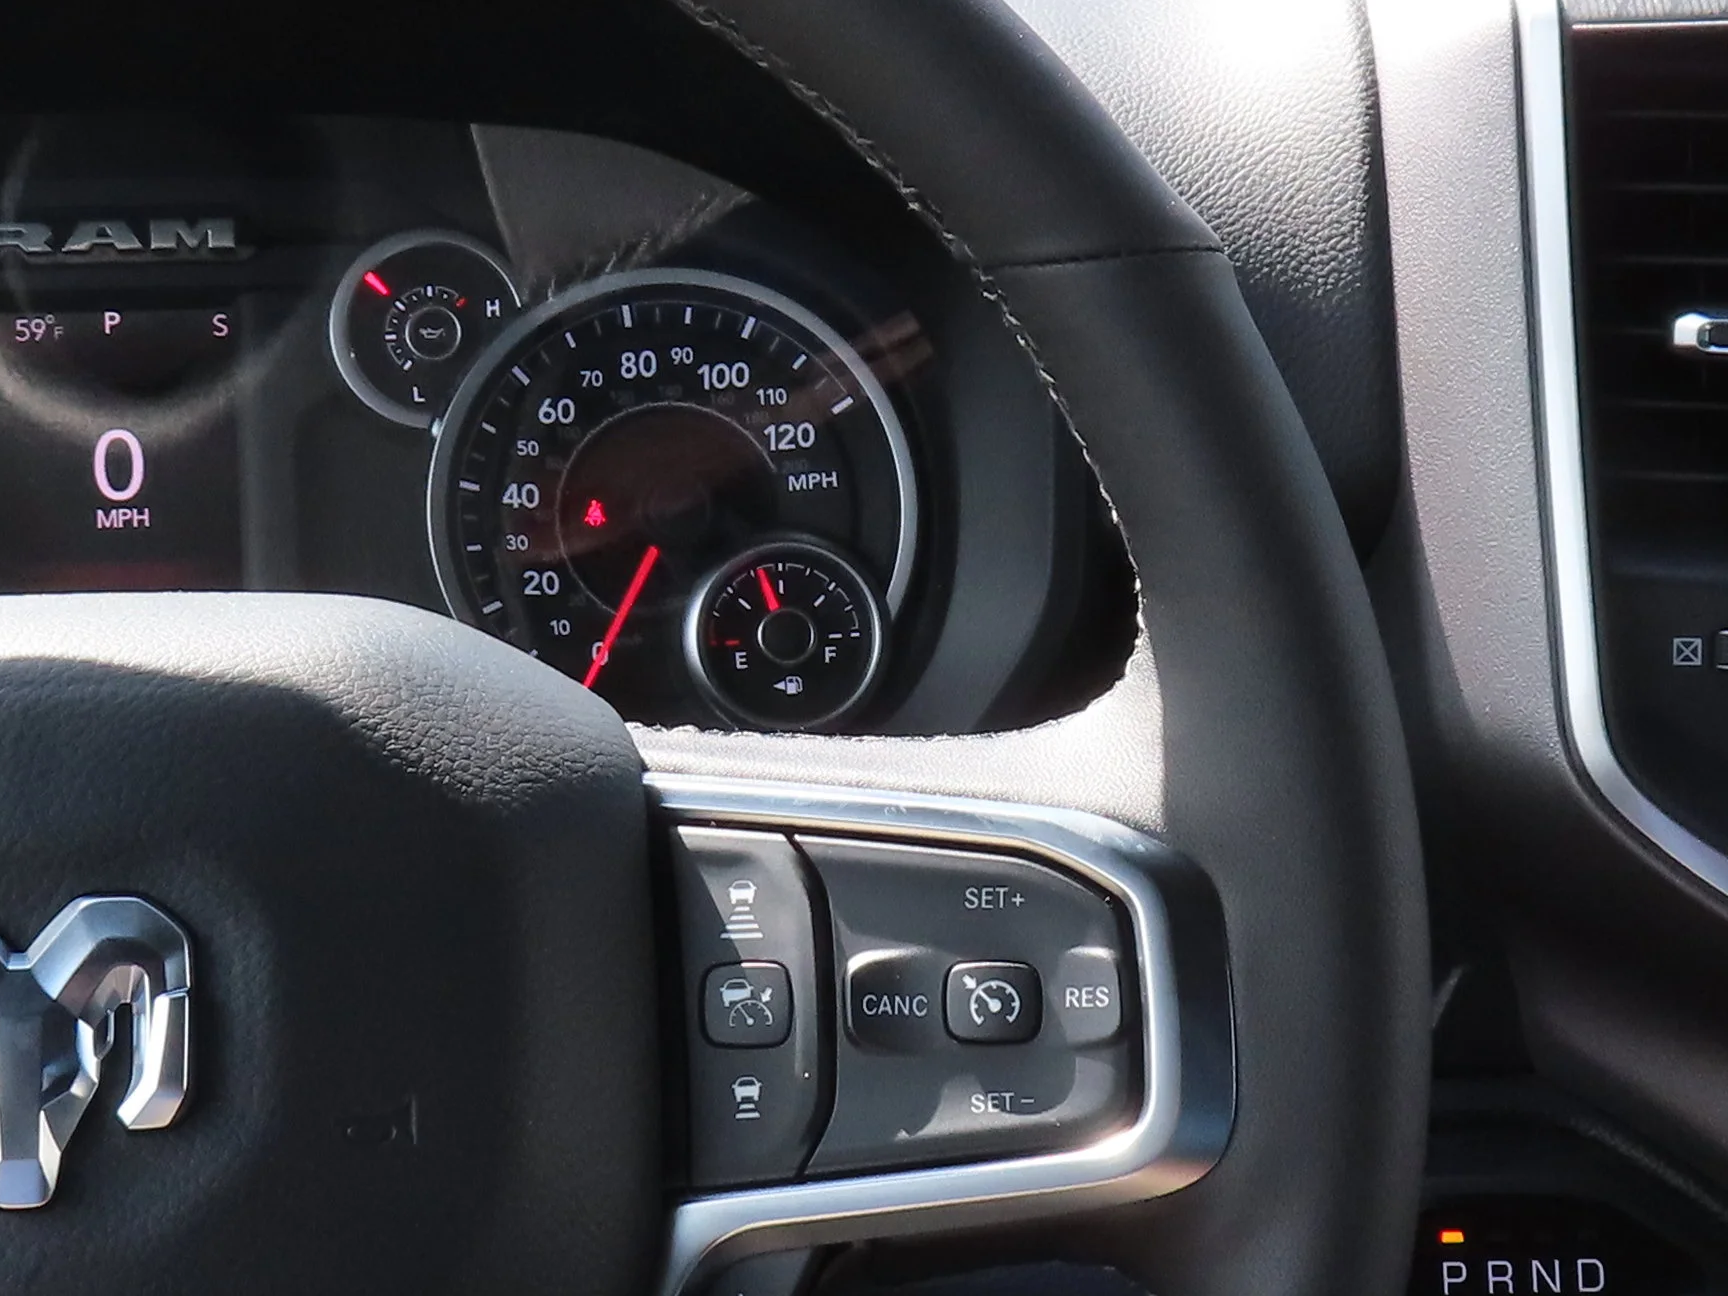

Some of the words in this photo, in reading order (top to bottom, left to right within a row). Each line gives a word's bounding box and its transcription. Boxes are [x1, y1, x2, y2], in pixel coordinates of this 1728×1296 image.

[486, 299, 501, 318] H
[104, 311, 121, 335] P
[212, 313, 229, 338] S
[619, 350, 657, 381] 80
[670, 346, 693, 366] 90
[580, 370, 603, 389] 70
[697, 361, 750, 391] 100
[412, 386, 426, 404] L
[756, 386, 788, 407] 110
[538, 397, 575, 426] 60
[763, 421, 816, 452] 120
[516, 439, 540, 458] 50
[91, 428, 146, 502] 0
[787, 470, 838, 492] MPH
[502, 482, 539, 510] 40
[96, 508, 151, 529] MPH
[505, 533, 529, 553] 30
[523, 570, 560, 598] 20
[549, 619, 571, 636] 10
[734, 650, 748, 670] E
[823, 645, 837, 664] F
[862, 994, 929, 1018] CANC
[1064, 986, 1110, 1008] RES
